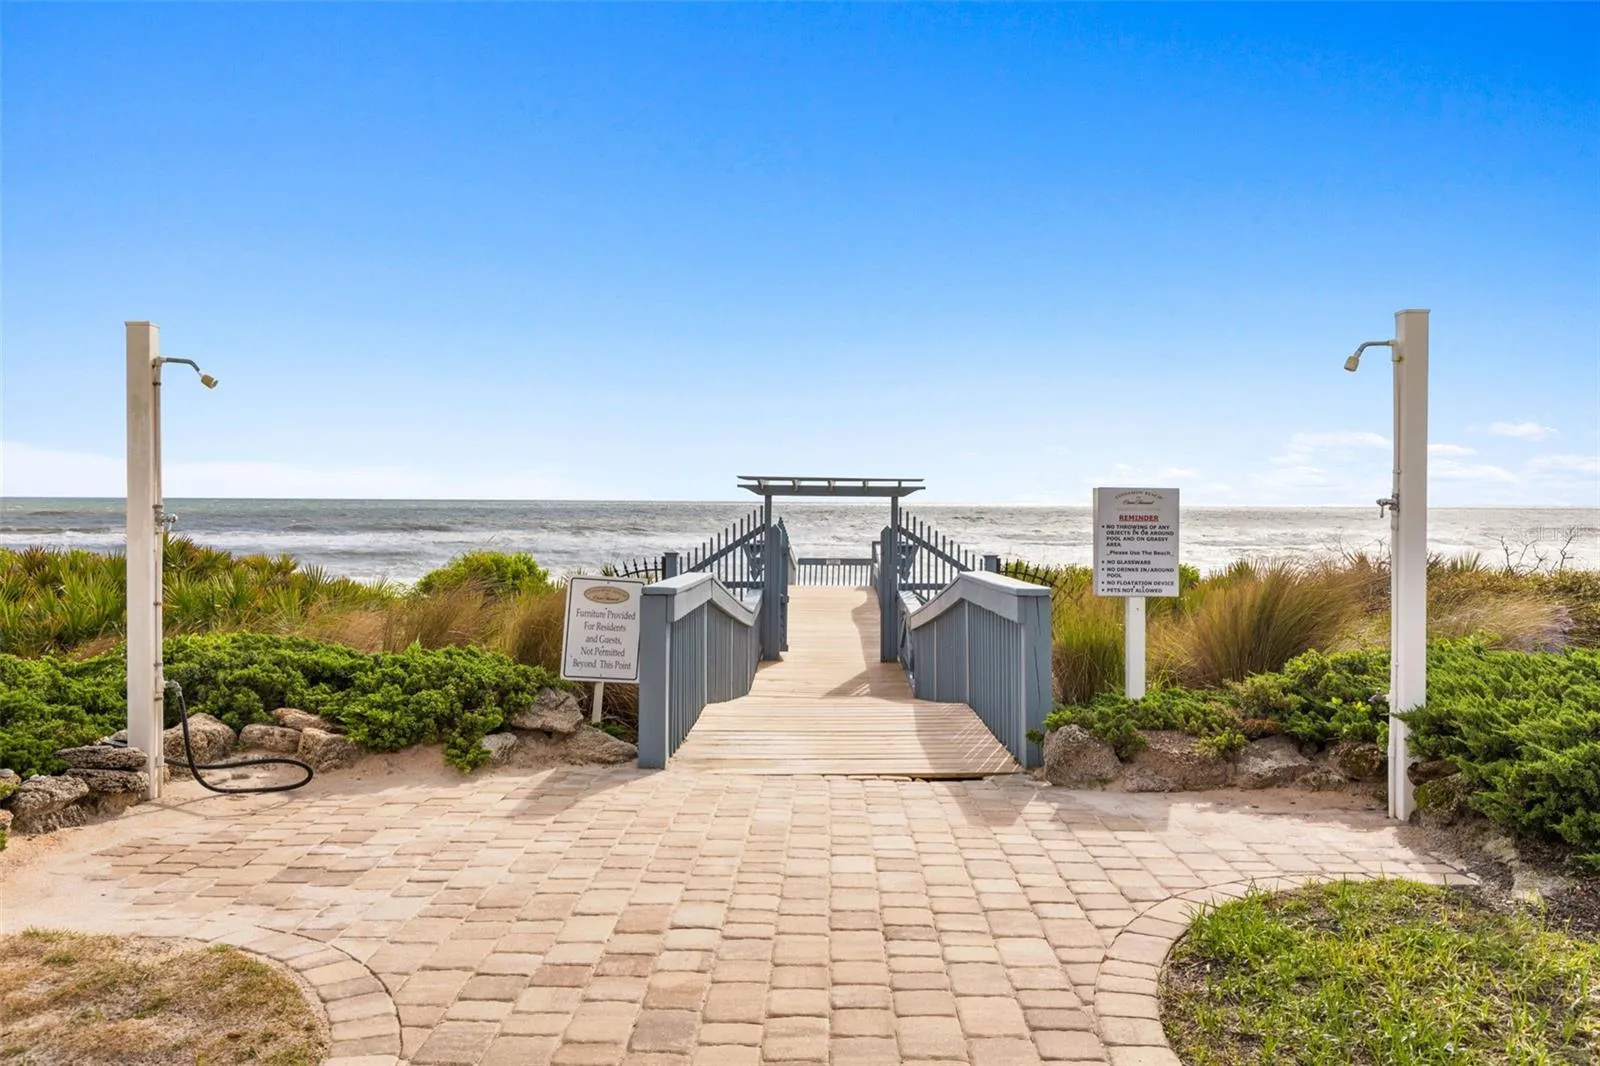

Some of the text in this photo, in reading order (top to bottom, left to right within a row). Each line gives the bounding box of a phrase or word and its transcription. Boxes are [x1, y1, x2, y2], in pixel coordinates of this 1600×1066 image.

[576, 608, 636, 620] Furniture Provided
[584, 621, 626, 632] For Residents
[585, 634, 622, 645] and Guests,
[580, 646, 625, 657] Not Permitted
[572, 658, 631, 670] Beyond This Point
